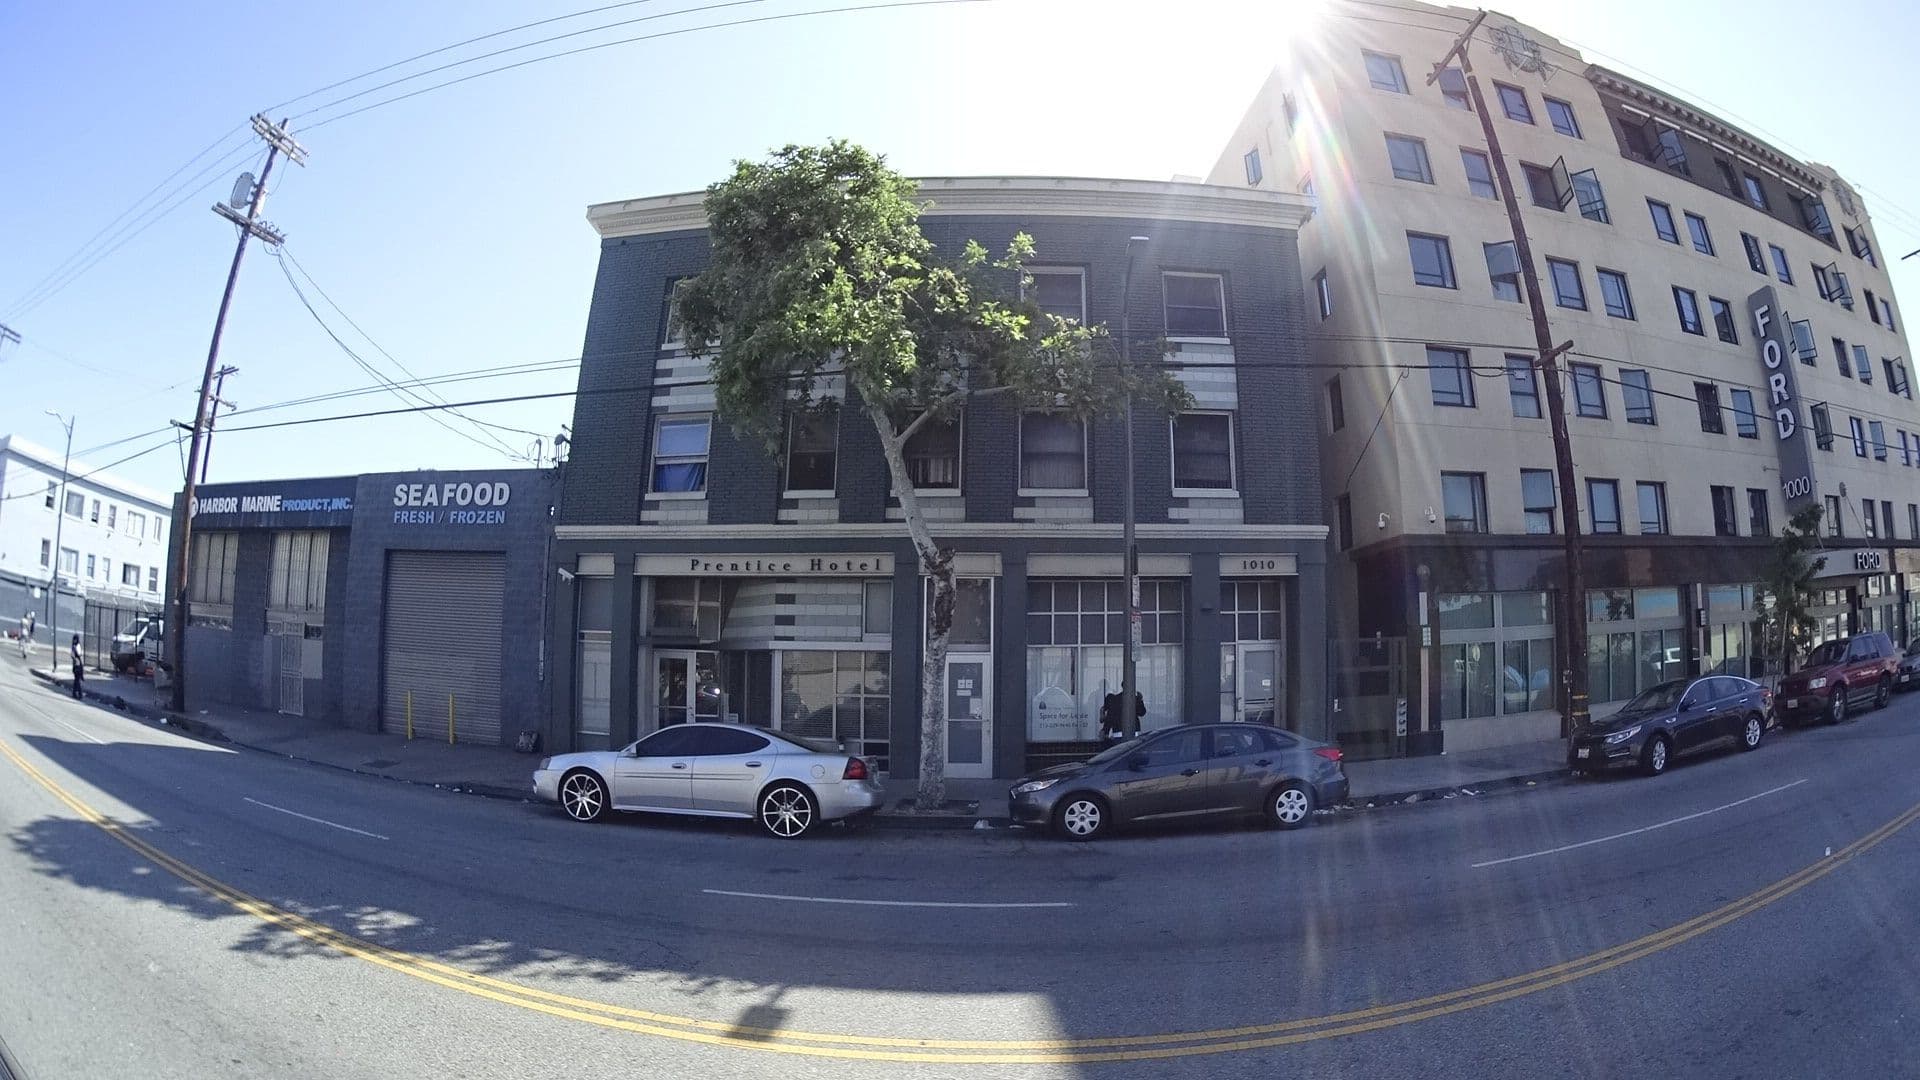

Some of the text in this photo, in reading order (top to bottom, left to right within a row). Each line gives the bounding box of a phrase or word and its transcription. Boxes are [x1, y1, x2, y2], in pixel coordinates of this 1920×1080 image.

[1754, 304, 1795, 440] FORD
[1783, 476, 1810, 500] 1000
[199, 497, 238, 514] HARBOR
[241, 495, 282, 513] MARINE
[393, 510, 435, 524] FRESH
[449, 510, 506, 524] FROZEN
[690, 558, 880, 572] Prentice Hotel
[1243, 560, 1275, 570] 1010
[1855, 552, 1881, 569] FORD
